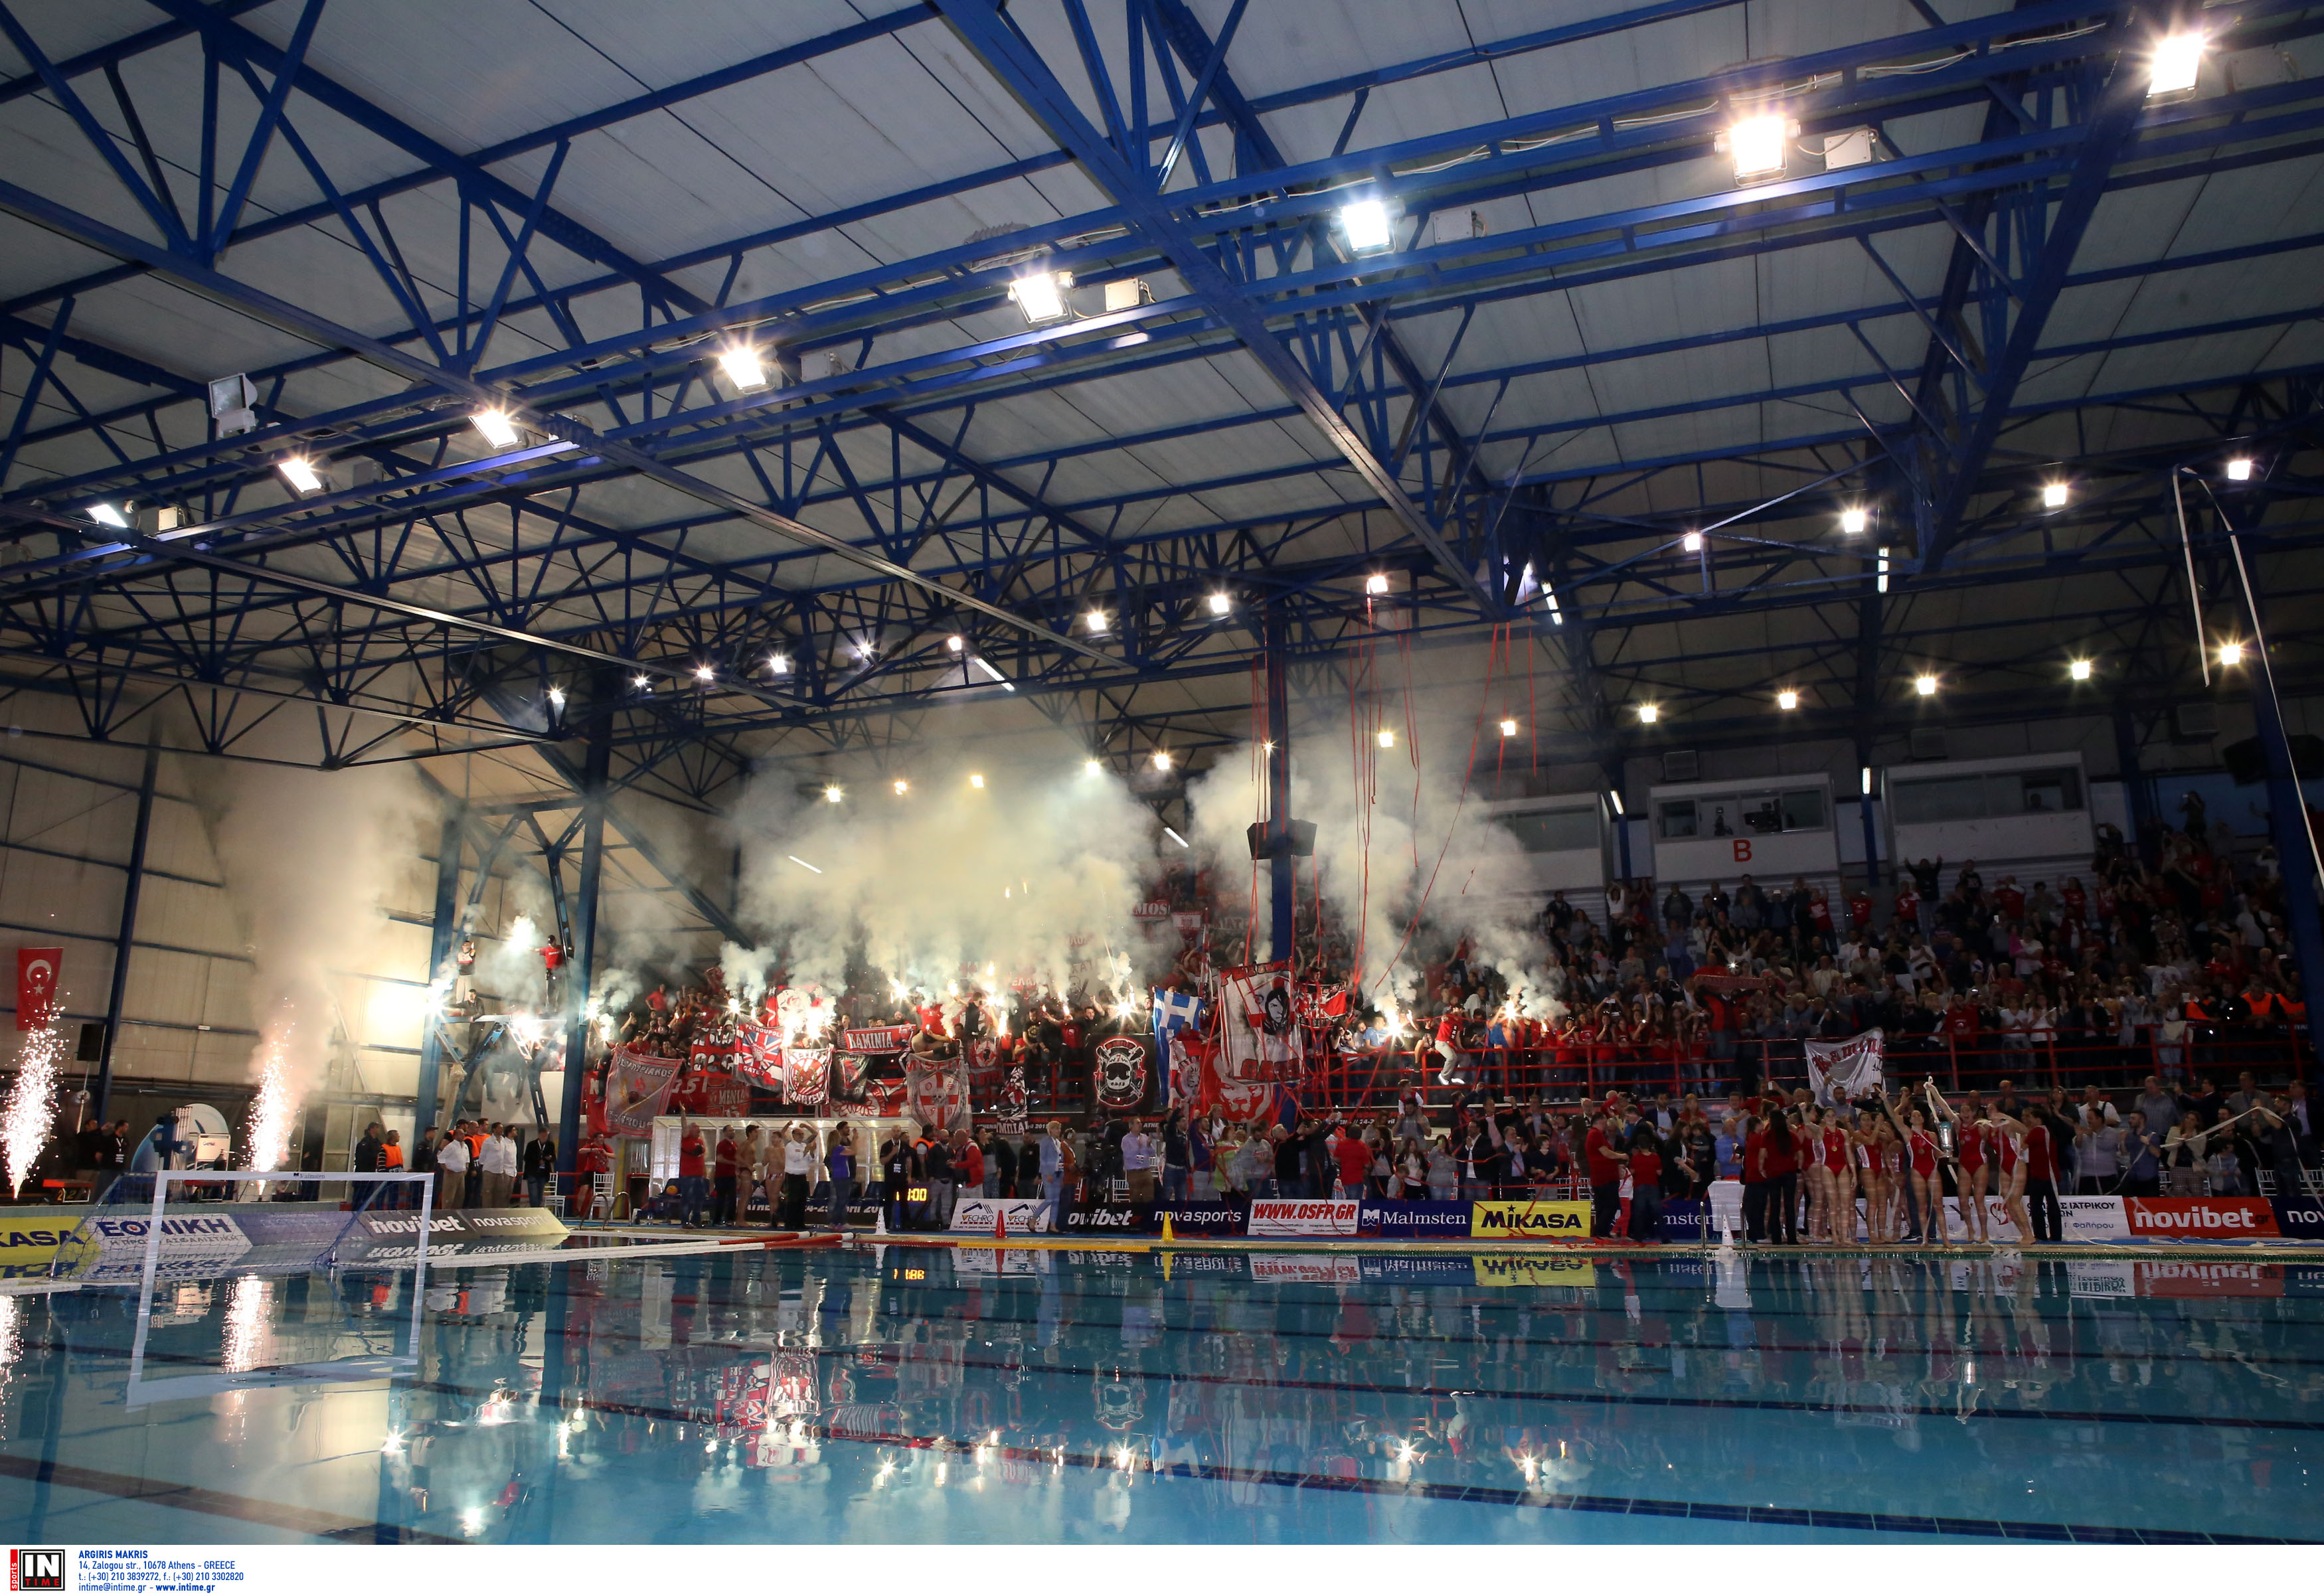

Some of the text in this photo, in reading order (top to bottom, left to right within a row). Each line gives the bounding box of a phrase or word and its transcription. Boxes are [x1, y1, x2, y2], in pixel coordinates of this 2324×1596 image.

[1733, 839, 1752, 862] B
[847, 1032, 894, 1049] KAMINIA
[743, 1065, 760, 1076] GATE
[1154, 1210, 1242, 1225] novasports
[1254, 1204, 1357, 1220] WWW.OSFP.GR
[1383, 1212, 1467, 1225] Malmsten
[473, 1214, 546, 1228] novasport
